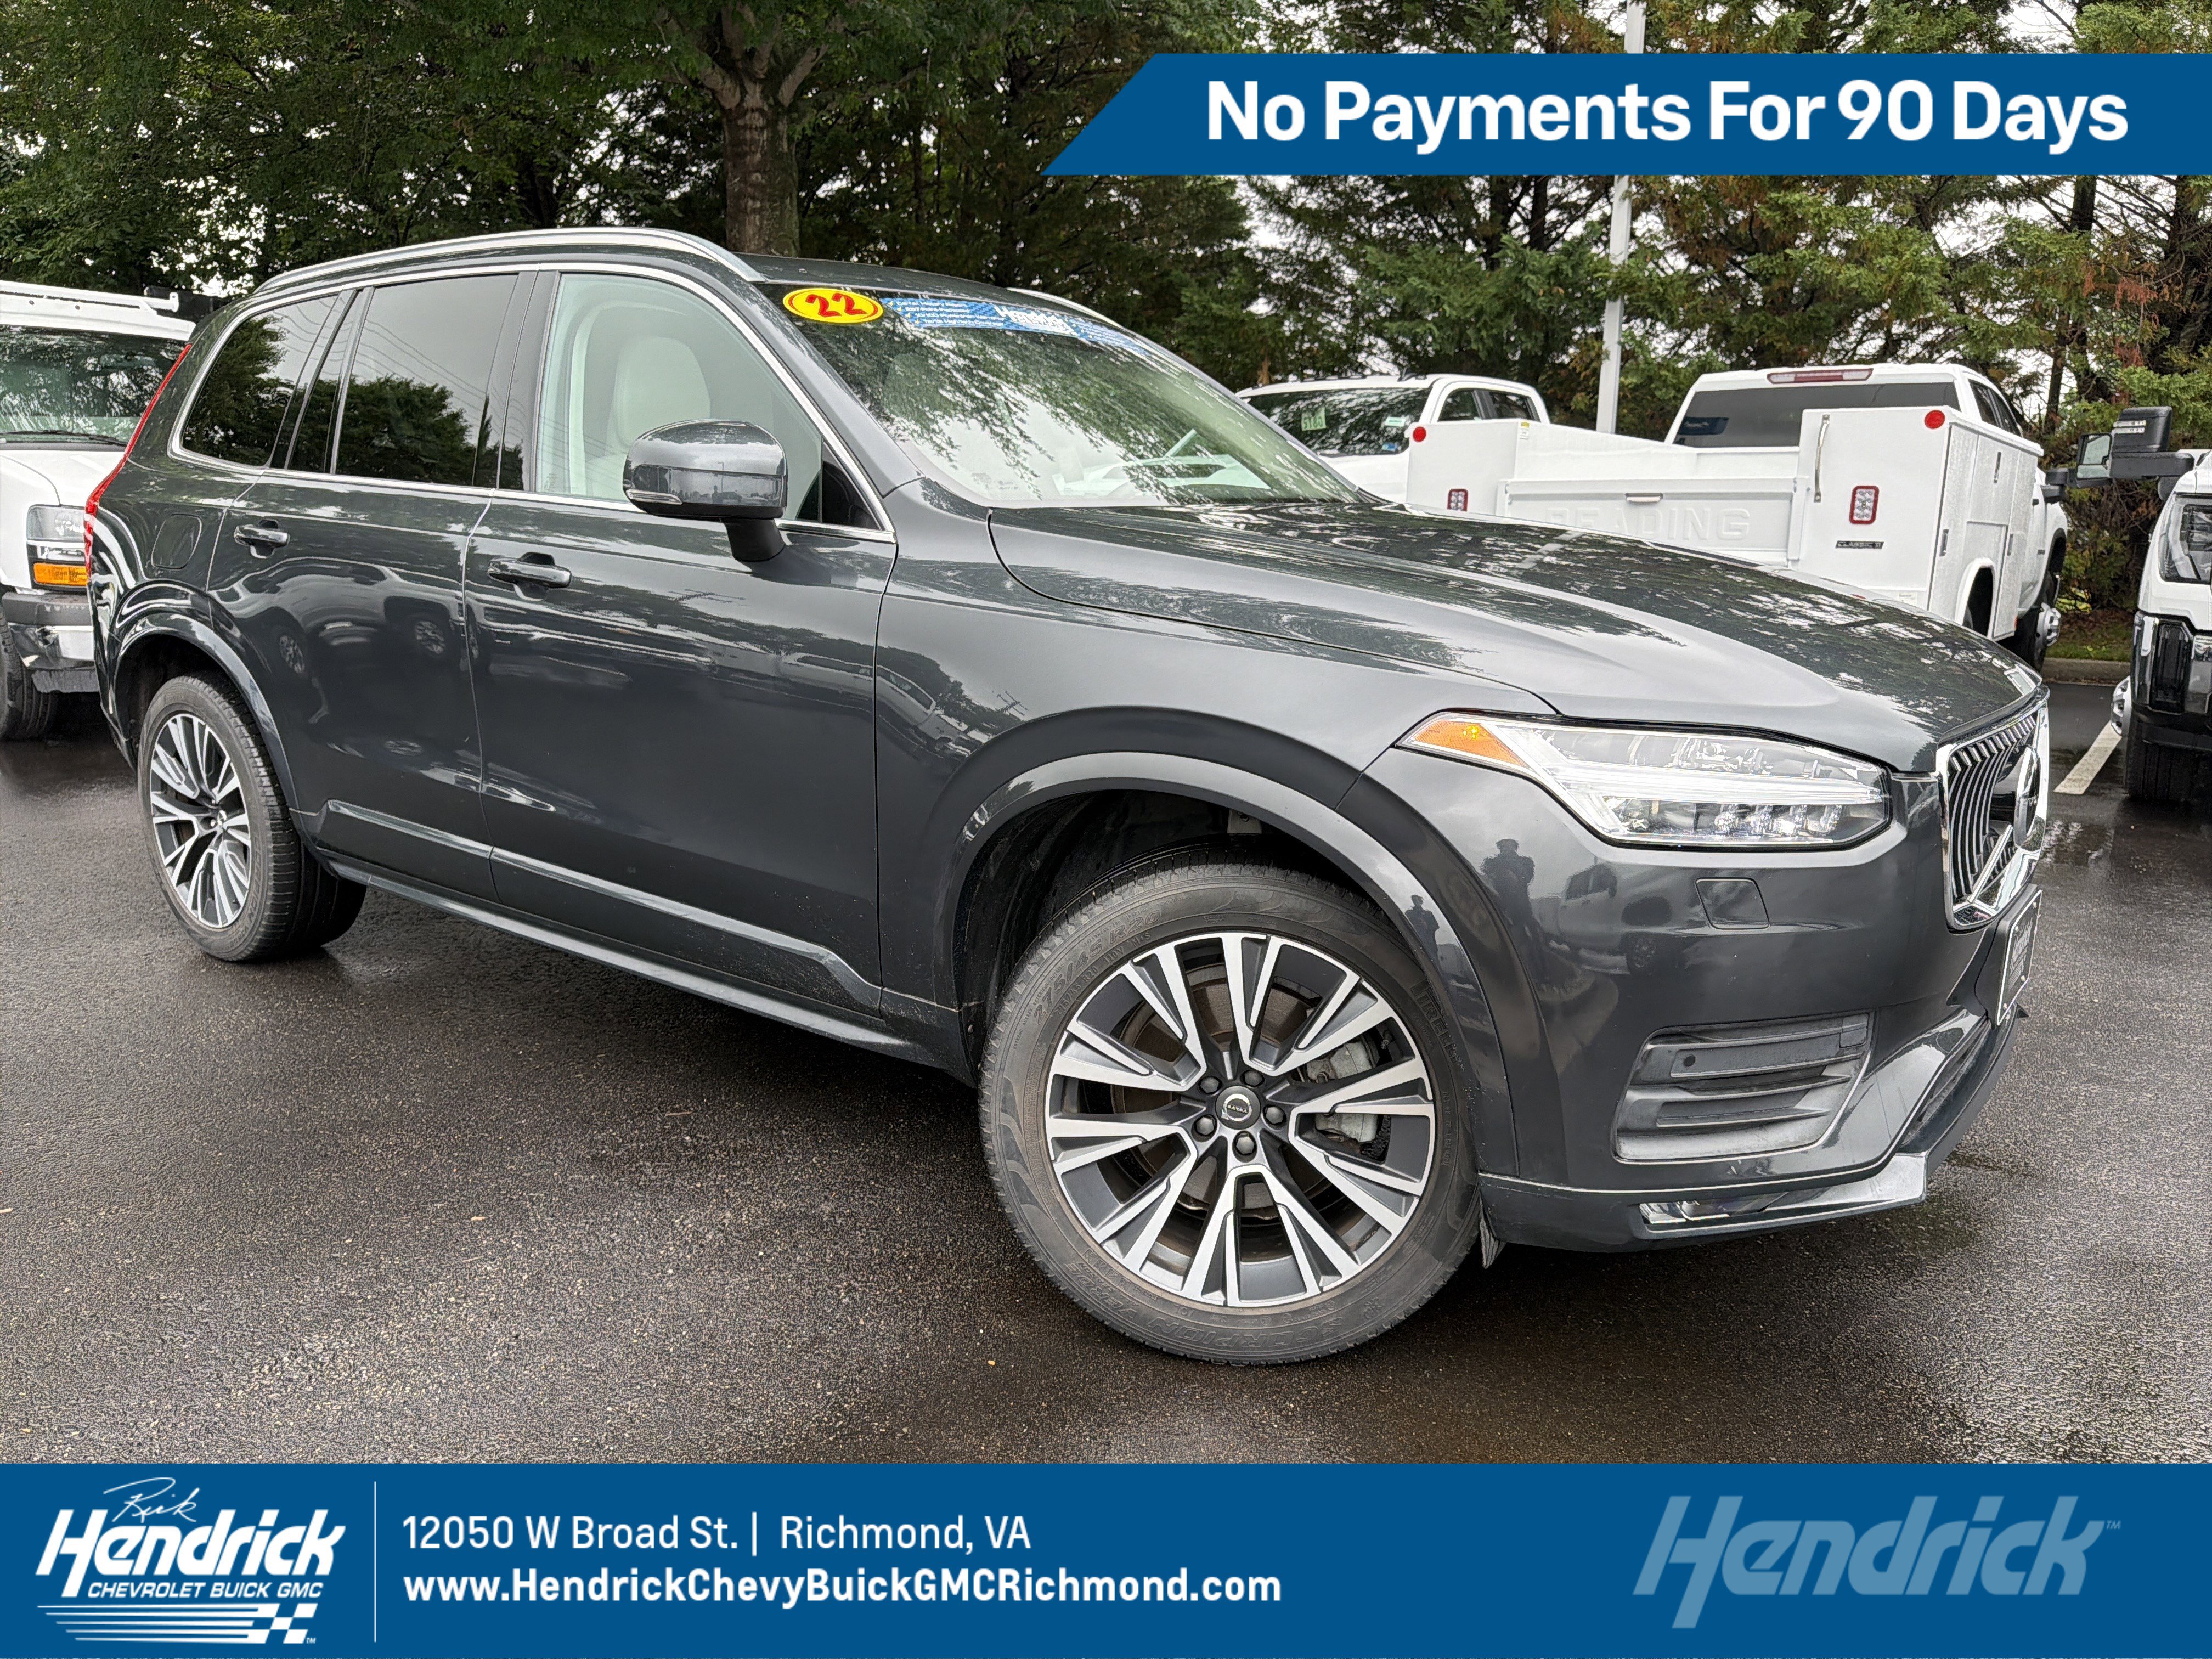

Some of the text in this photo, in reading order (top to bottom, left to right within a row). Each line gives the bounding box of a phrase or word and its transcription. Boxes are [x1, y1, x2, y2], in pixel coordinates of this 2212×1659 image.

[805, 293, 867, 317] 22
[1035, 910, 1162, 1025] 275/45 R20
[1082, 966, 1098, 983] R20
[1227, 1104, 1248, 1114] VOLVO
[1146, 1317, 1342, 1348] SCORPION
